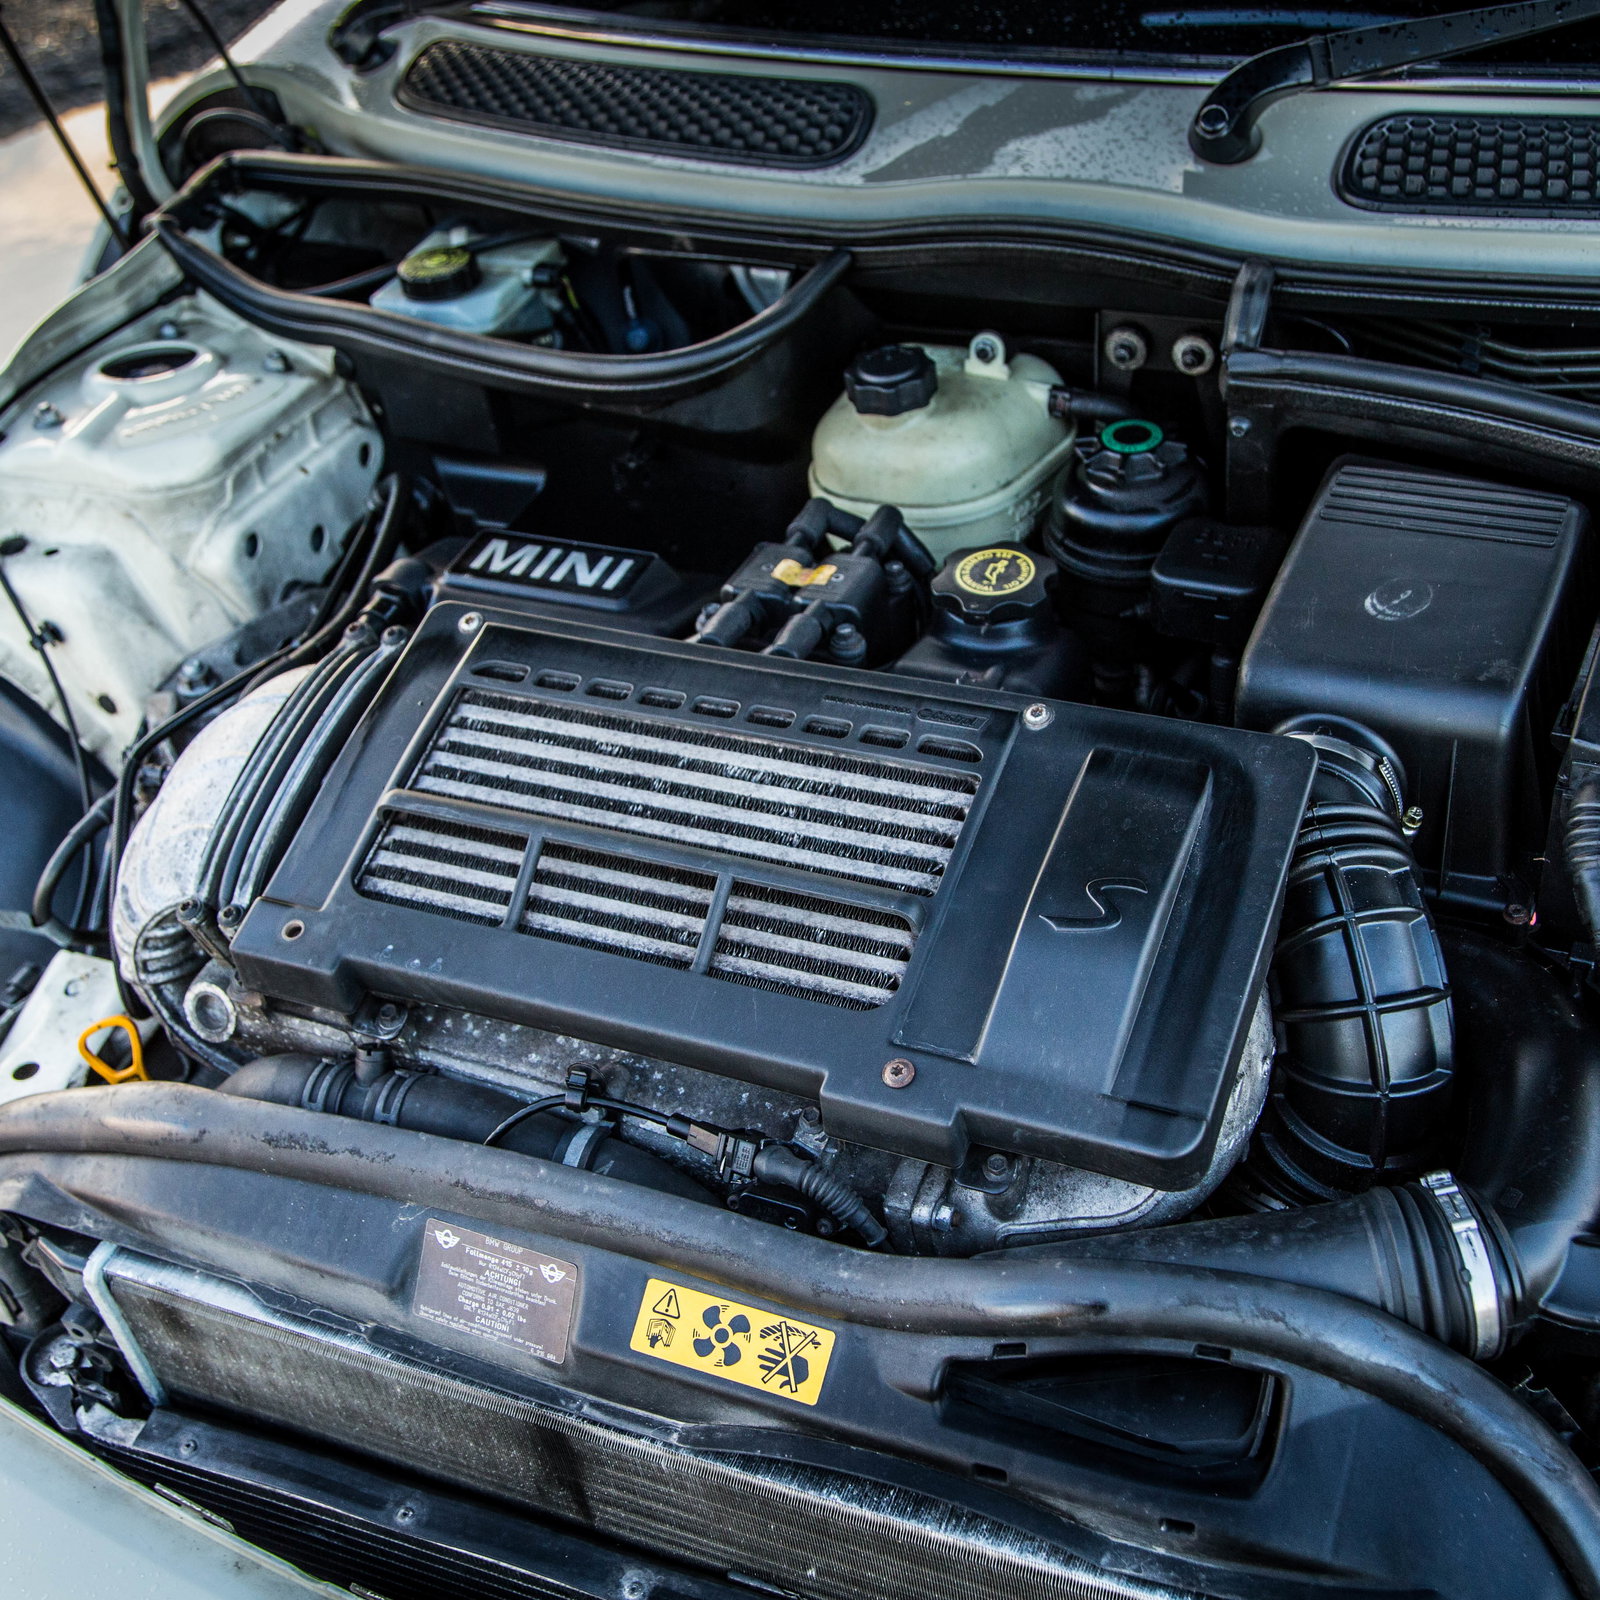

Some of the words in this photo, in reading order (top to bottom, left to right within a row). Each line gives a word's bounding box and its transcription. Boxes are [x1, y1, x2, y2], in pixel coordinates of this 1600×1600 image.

[469, 538, 635, 590] MINI
[1039, 877, 1148, 932] S
[485, 1237, 499, 1247] BMW
[503, 1243, 523, 1255] GROUP
[484, 1269, 521, 1287] ACHTUNG!
[457, 1295, 479, 1308] Charge
[475, 1315, 509, 1332] CAUTION!
